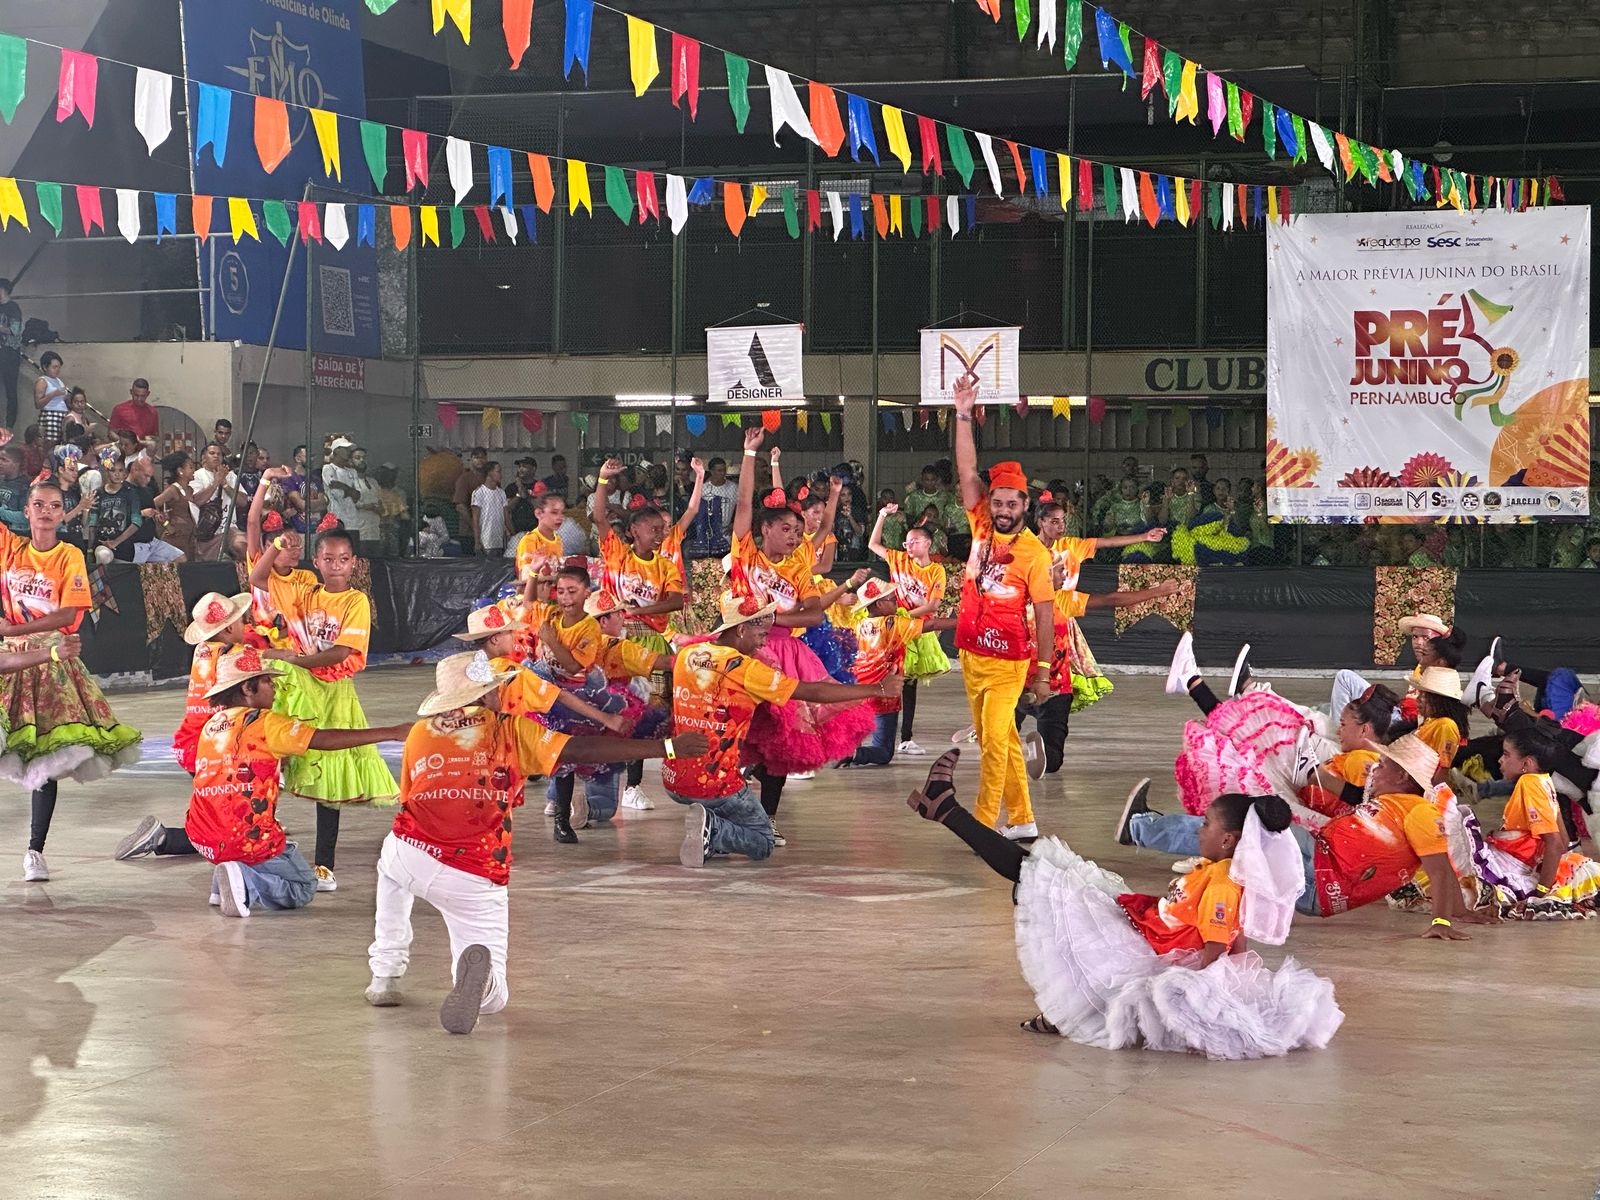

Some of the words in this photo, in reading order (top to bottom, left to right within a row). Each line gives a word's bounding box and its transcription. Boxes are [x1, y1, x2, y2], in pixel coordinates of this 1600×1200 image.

[309, 3, 320, 20] de
[321, 7, 351, 31] Olinda
[1405, 223, 1444, 231] REALIZAÇÃO
[1426, 236, 1462, 248] Sesc
[1296, 269, 1306, 281] A
[1310, 269, 1359, 281] MAIOR
[1363, 266, 1415, 280] PRÉVIA
[1419, 266, 1476, 281] JUNINA
[1481, 265, 1505, 278] DO
[1511, 264, 1561, 277] BRASIL
[1354, 293, 1462, 357] PRÉ
[318, 357, 344, 373] SAÍDA
[345, 362, 358, 374] DE
[1144, 356, 1267, 392] CLUB
[1349, 357, 1470, 385] JUNINO
[727, 388, 783, 400] DESIGNER
[1350, 391, 1467, 405] PERNAMBUCO
